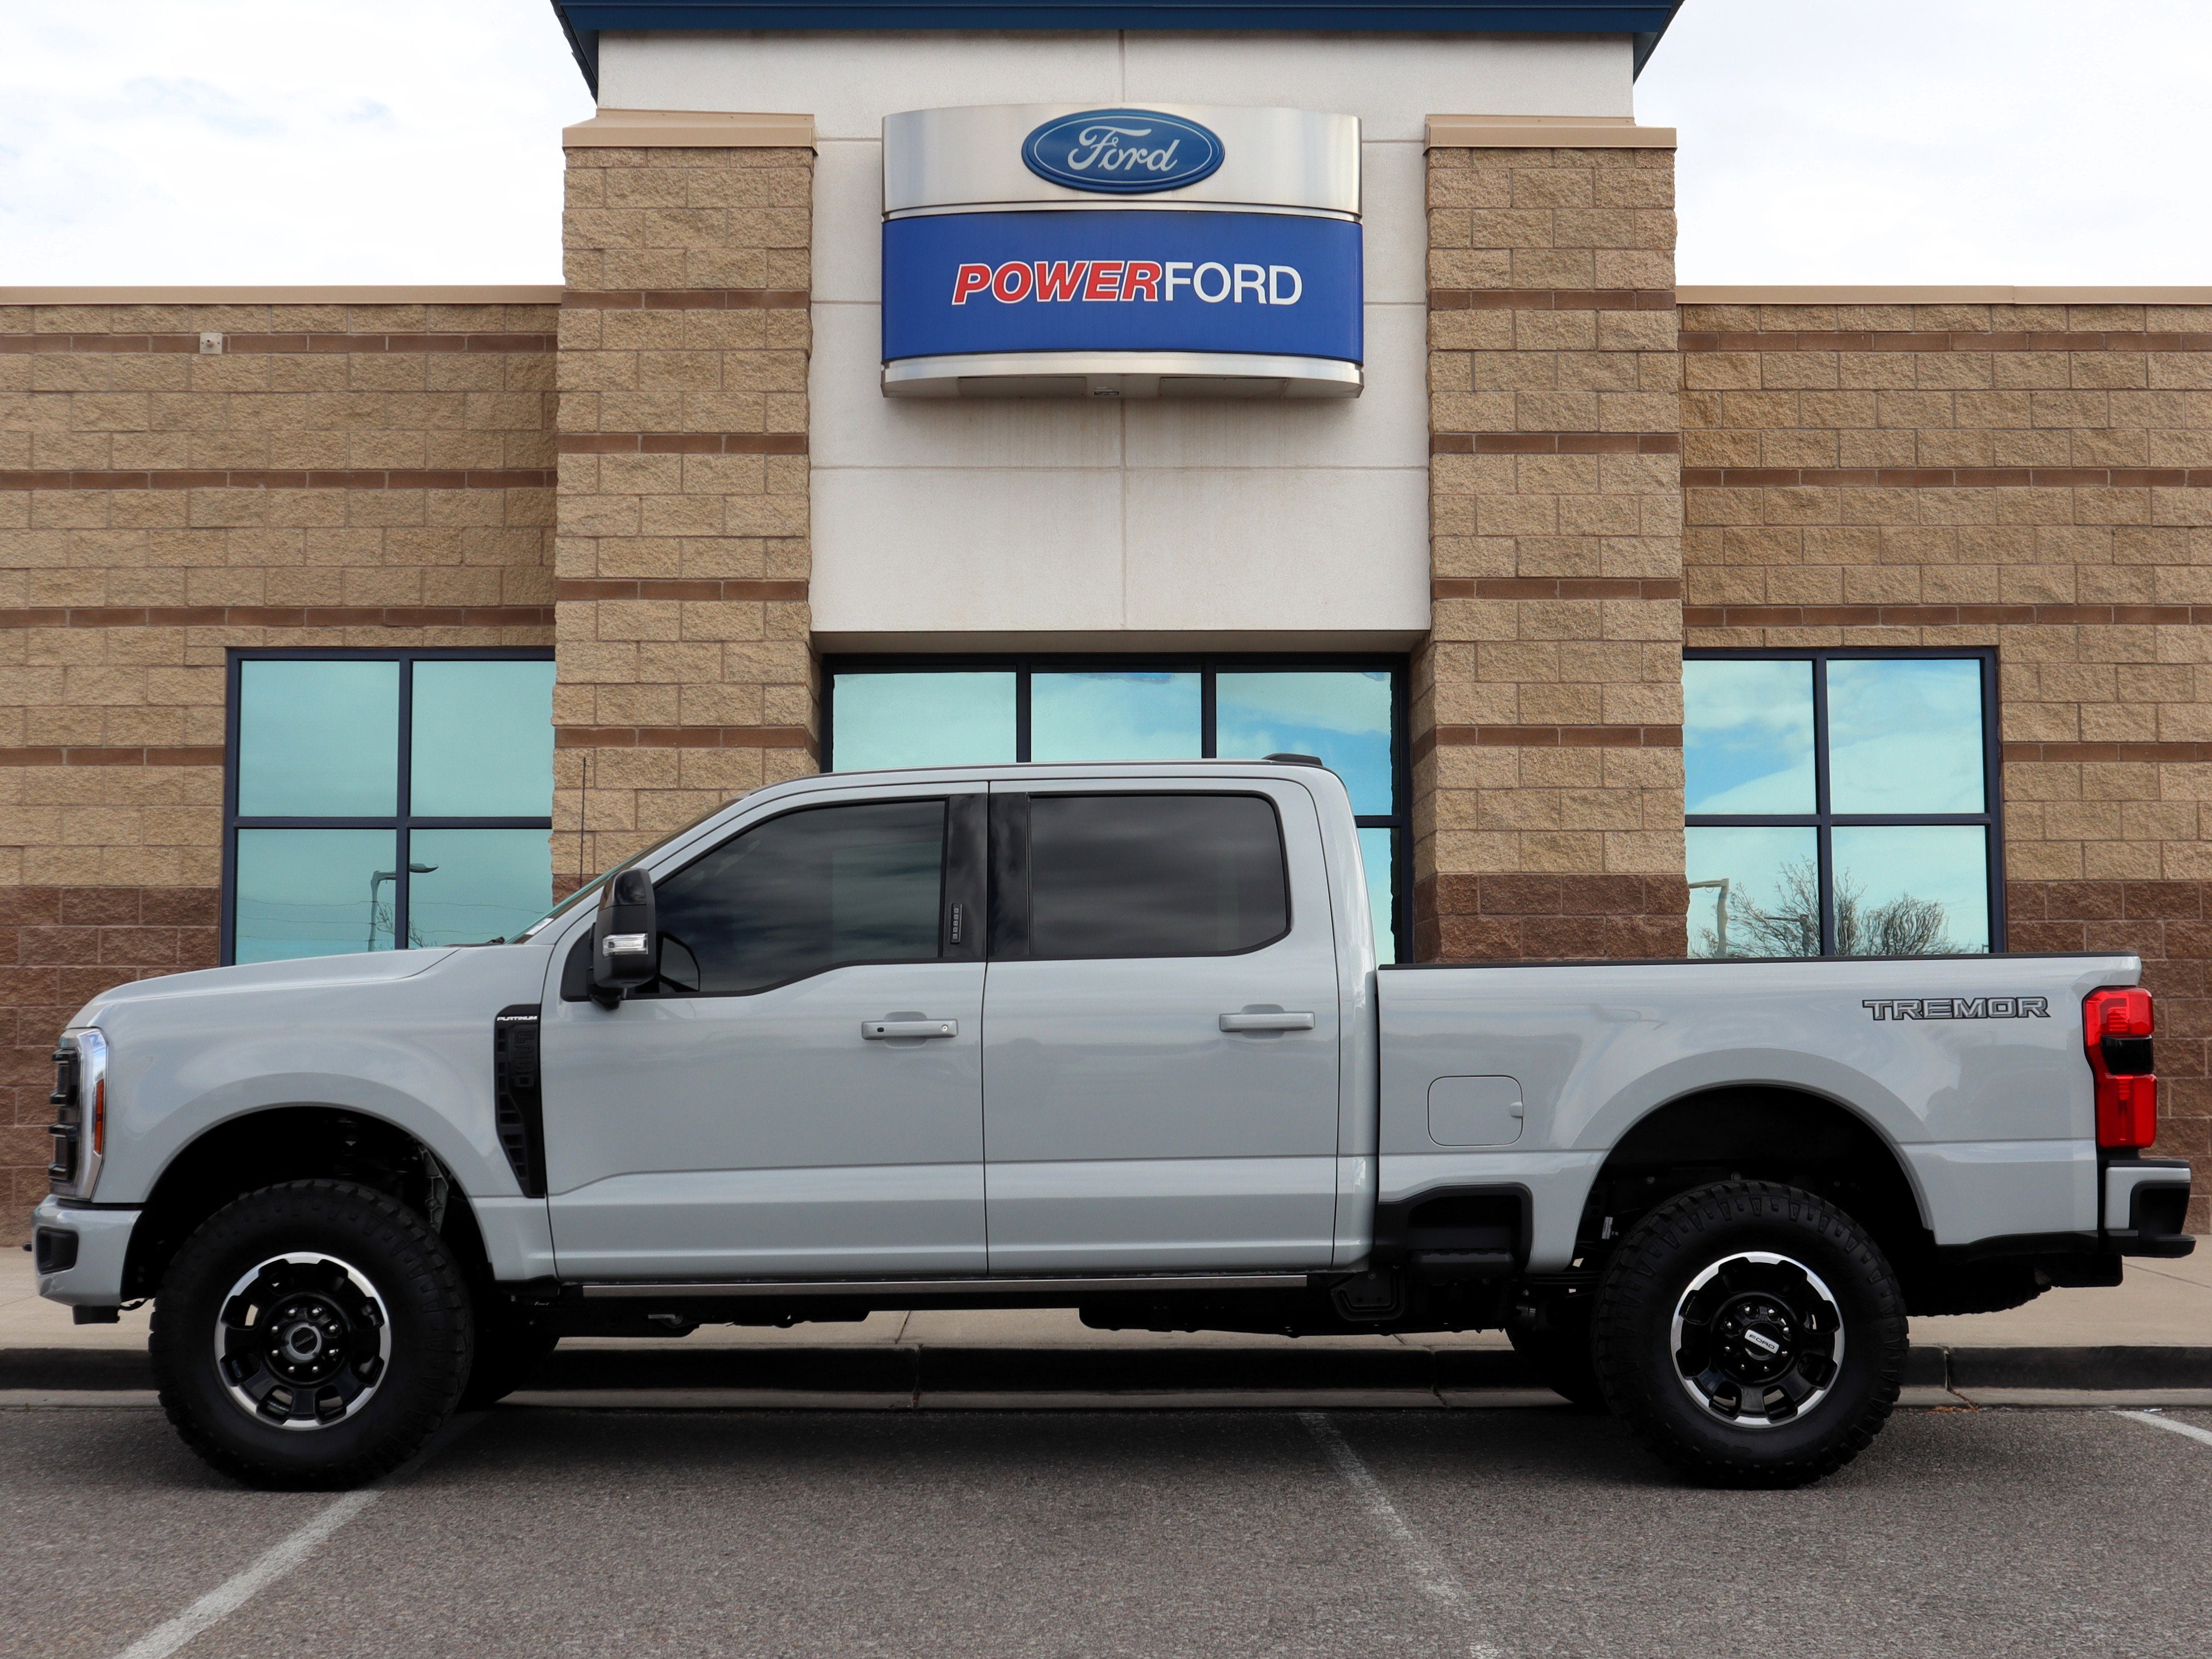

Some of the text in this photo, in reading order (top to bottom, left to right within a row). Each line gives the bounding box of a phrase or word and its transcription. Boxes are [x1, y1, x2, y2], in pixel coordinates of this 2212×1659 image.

[1067, 125, 1181, 171] Ford
[951, 260, 1303, 305] POWERFORD
[1862, 996, 2051, 1021] TREMOR
[1749, 1334, 1775, 1349] FORD
